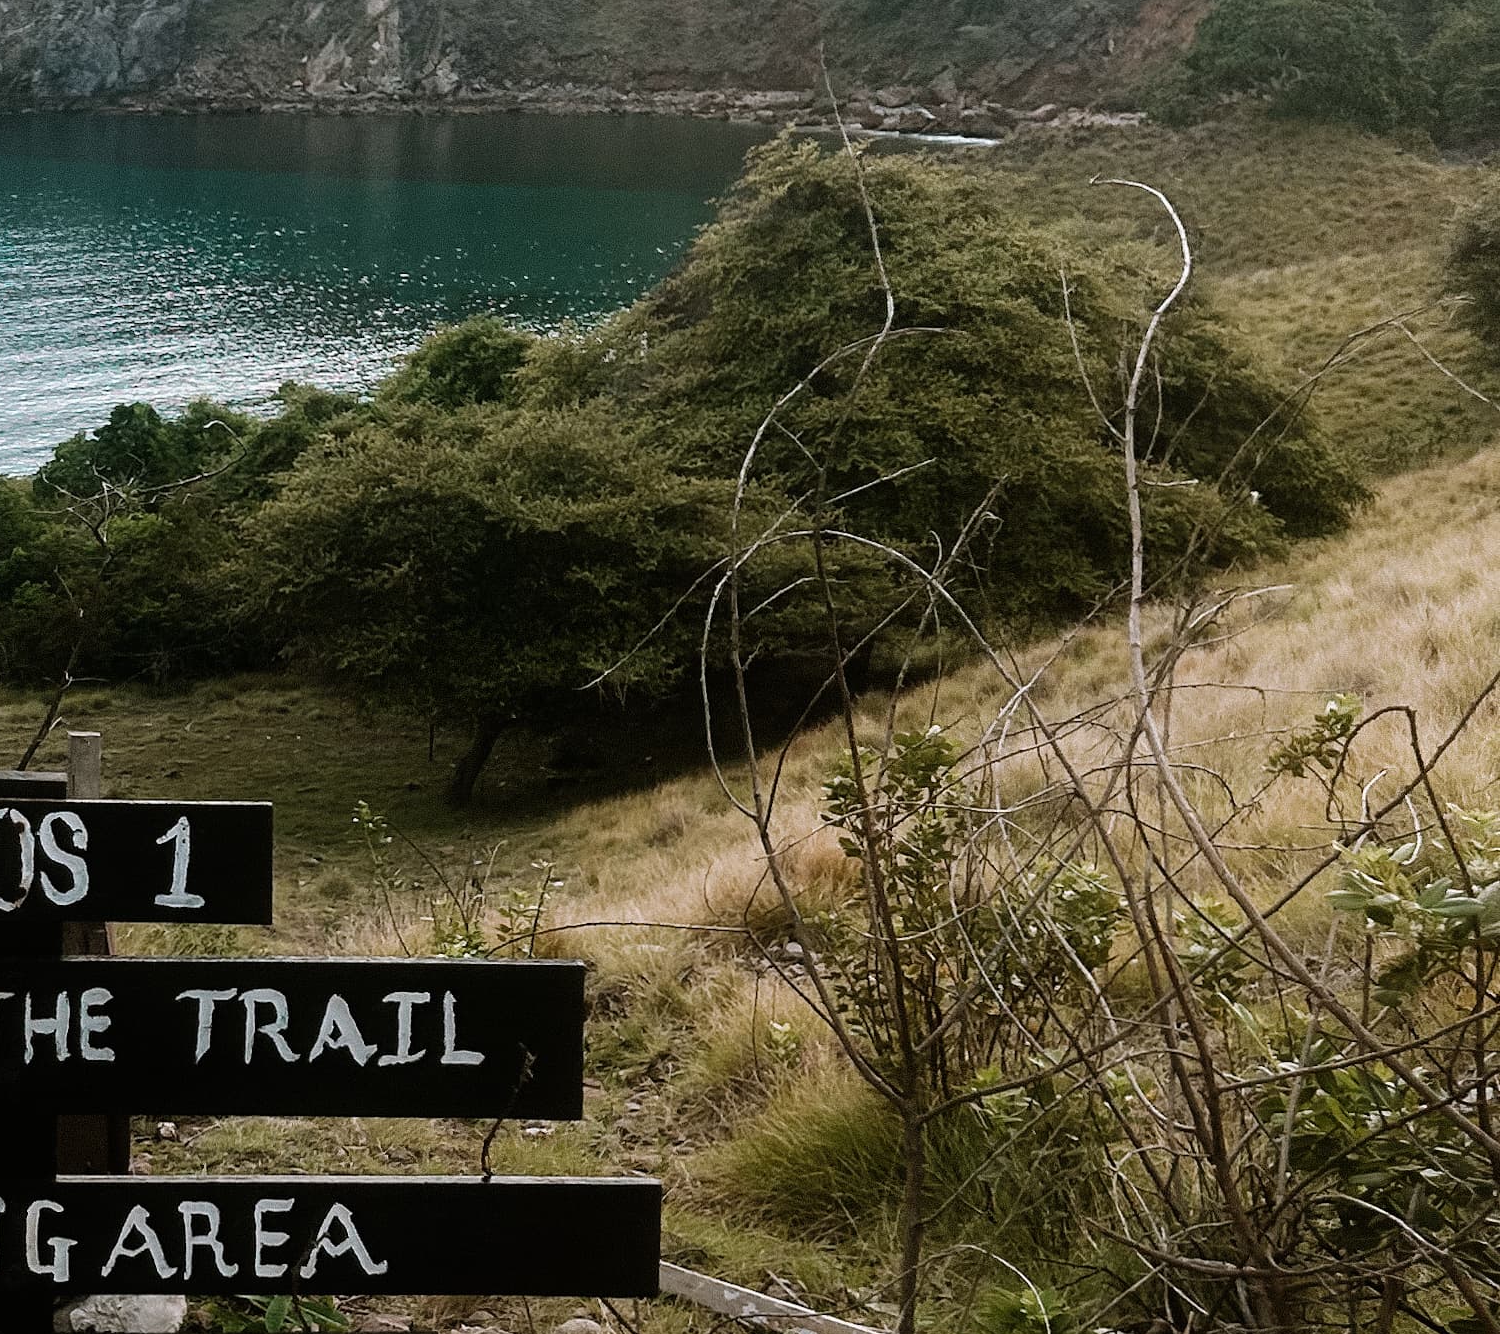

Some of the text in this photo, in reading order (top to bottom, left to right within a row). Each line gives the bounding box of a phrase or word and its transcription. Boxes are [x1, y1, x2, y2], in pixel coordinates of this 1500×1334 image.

[154, 816, 205, 908] 1
[175, 988, 485, 1067] TRAIL
[101, 1198, 388, 1280] AREA
